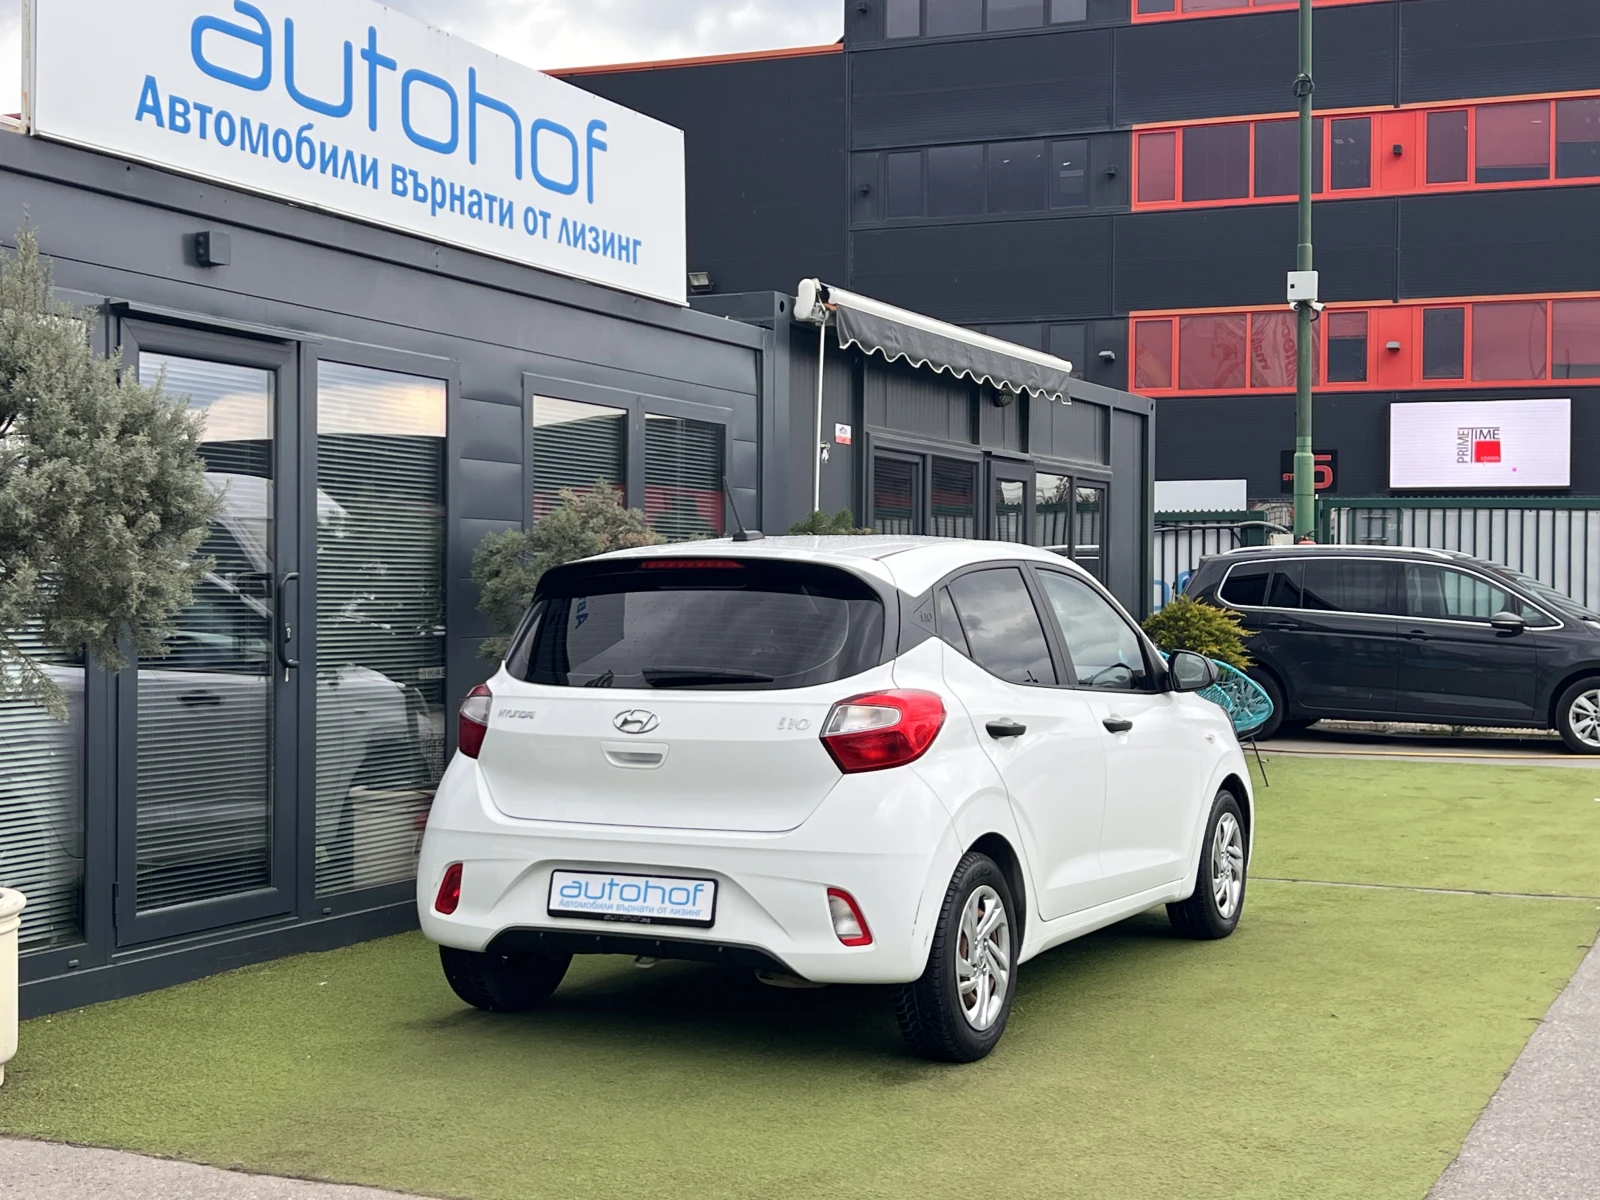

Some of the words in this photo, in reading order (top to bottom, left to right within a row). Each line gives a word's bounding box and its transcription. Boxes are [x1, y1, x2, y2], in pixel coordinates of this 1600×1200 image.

[190, 0, 608, 204] autohof
[135, 74, 379, 190] Автомобили
[391, 163, 514, 229] върнати
[523, 206, 551, 239] от
[557, 217, 642, 265] лизинг
[1457, 429, 1469, 464] PRIME
[558, 898, 614, 910] Автомобили
[616, 903, 655, 913] върнати
[657, 906, 667, 915] от
[669, 907, 703, 917] лизинг
[559, 877, 704, 907] autohof
